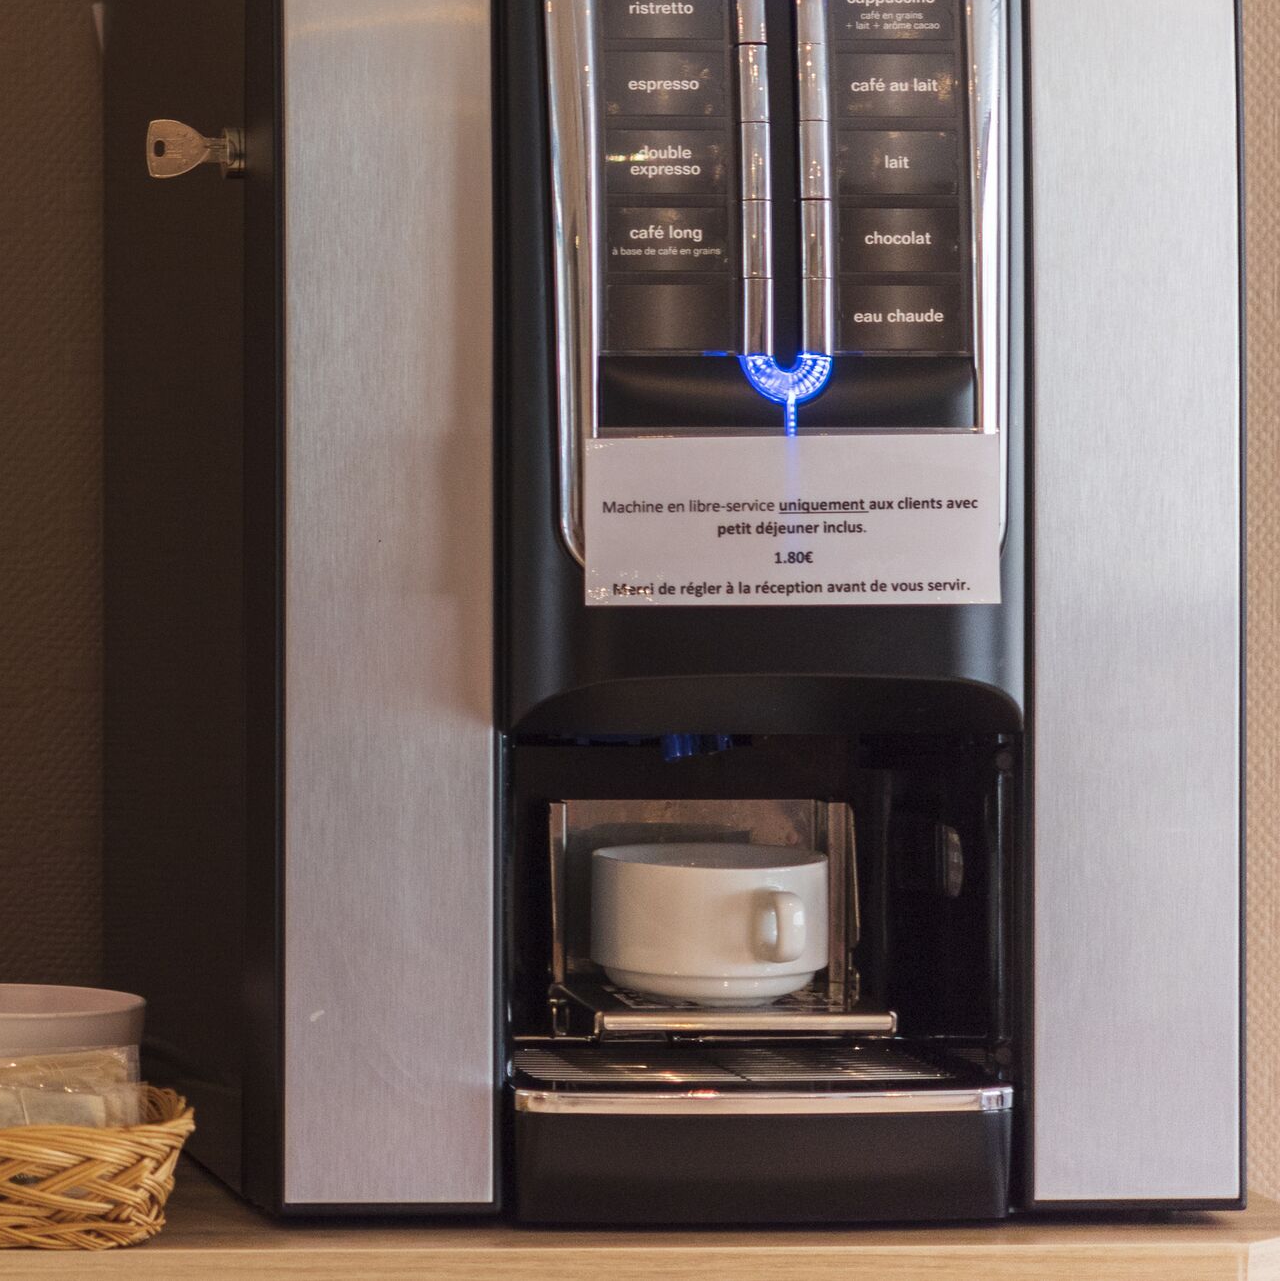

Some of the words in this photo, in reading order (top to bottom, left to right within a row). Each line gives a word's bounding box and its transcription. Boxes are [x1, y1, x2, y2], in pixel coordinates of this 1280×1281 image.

[628, 1, 694, 15] ristretto
[860, 10, 880, 20] café
[882, 12, 893, 20] en
[895, 11, 924, 22] grains
[855, 21, 870, 30] lait
[913, 22, 940, 30] cacao
[627, 79, 700, 94] espresso
[850, 77, 885, 92] café
[889, 80, 909, 92] au
[913, 77, 938, 92] lait
[638, 145, 692, 159] double
[884, 155, 910, 169] lait
[630, 164, 701, 179] expresso
[629, 225, 665, 240] café
[668, 225, 703, 242] long
[864, 231, 932, 245] chocolat
[611, 246, 618, 256] à
[620, 246, 643, 256] base
[644, 246, 656, 256] de
[657, 246, 678, 256] café
[679, 248, 692, 256] en
[693, 246, 721, 258] grains
[853, 311, 883, 323] eau
[886, 308, 944, 323] chaude
[602, 500, 663, 514] Machine
[667, 503, 685, 513] en
[689, 499, 775, 513] libre-service
[778, 498, 865, 514] uniquement
[868, 500, 894, 510] aux
[897, 496, 943, 510] clients
[946, 499, 979, 509] avec
[717, 522, 752, 538] petit
[755, 521, 820, 537] déjeuner
[823, 520, 867, 534] inclus.
[774, 551, 814, 565] 1.80€
[612, 582, 654, 596] Merci
[658, 582, 676, 595] de
[680, 581, 722, 598] régler
[726, 581, 734, 595] à
[738, 581, 751, 594] la
[755, 580, 823, 596] réception
[827, 581, 866, 593] avant
[870, 579, 888, 592] de
[891, 582, 924, 592] vous
[927, 578, 971, 591] servir.
